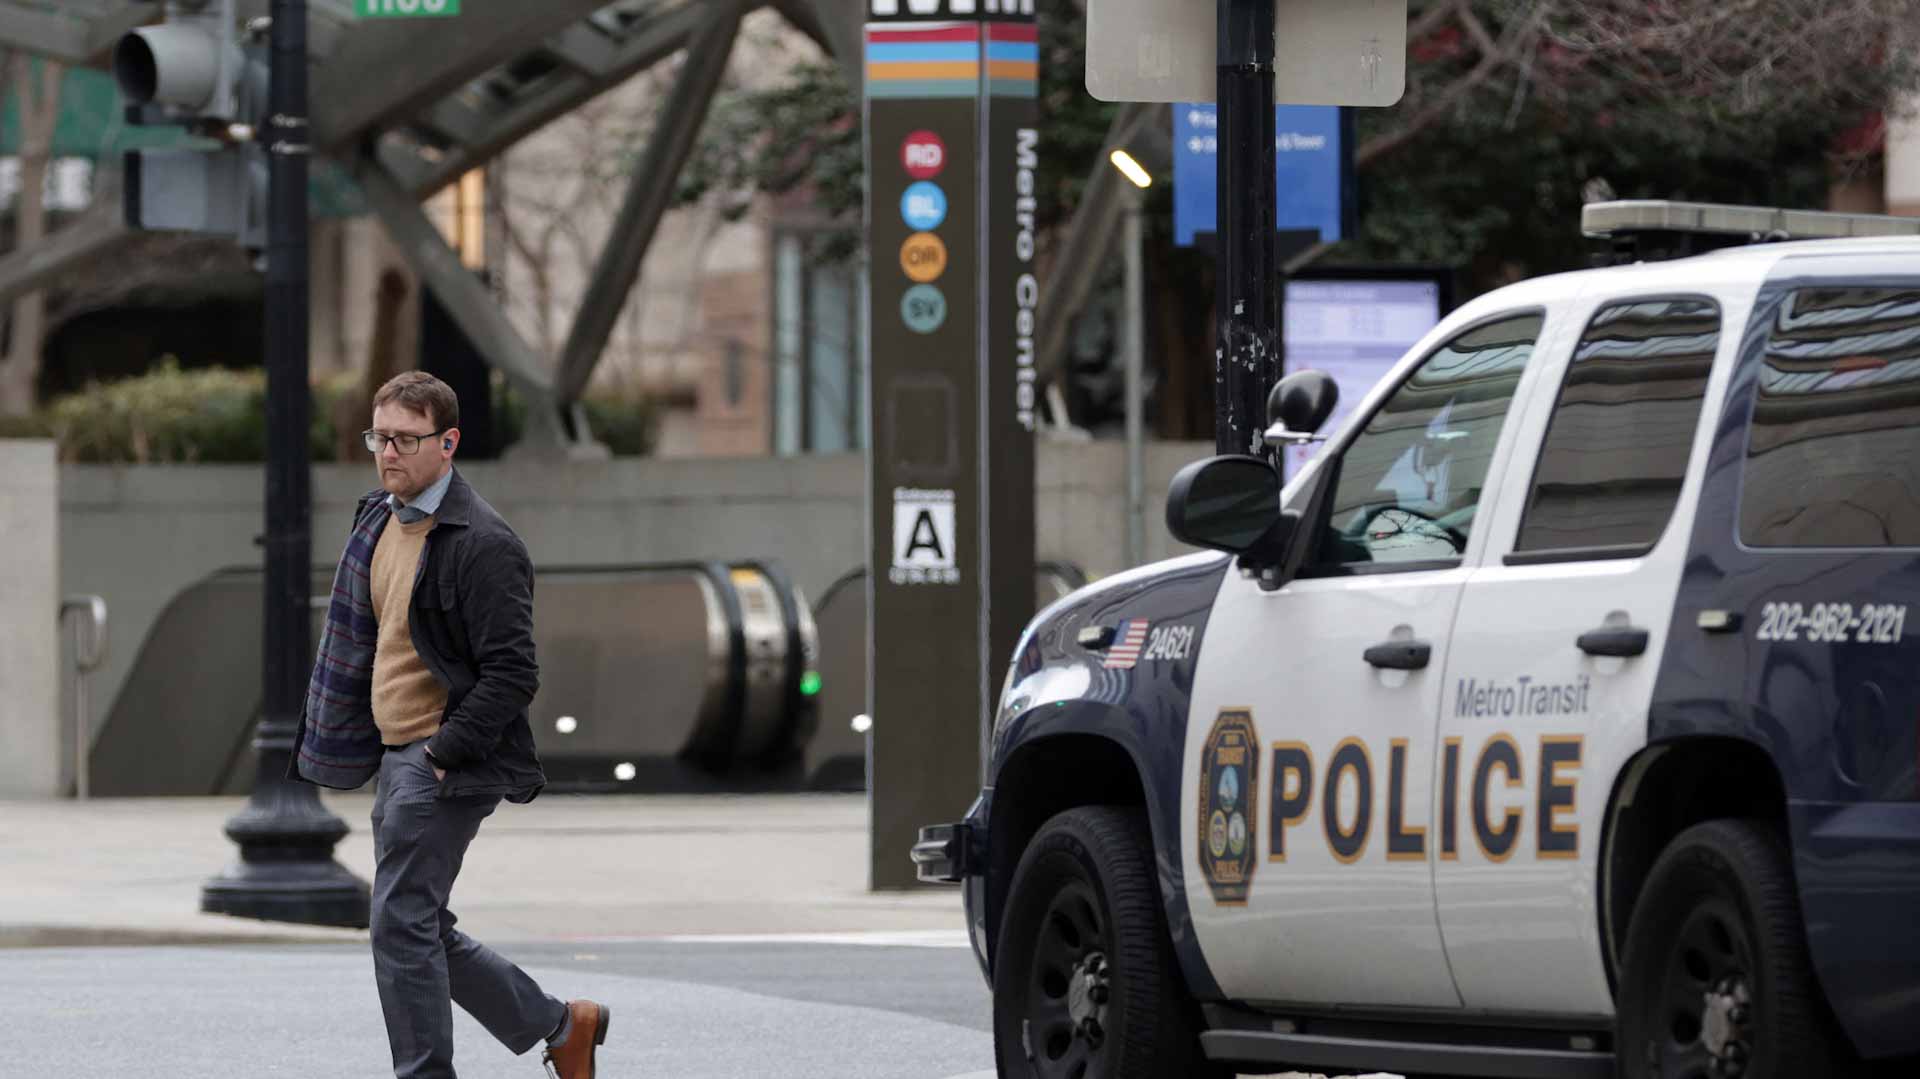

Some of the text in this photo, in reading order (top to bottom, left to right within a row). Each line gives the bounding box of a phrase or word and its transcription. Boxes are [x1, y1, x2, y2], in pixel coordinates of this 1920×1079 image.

[905, 143, 943, 168] RD
[907, 194, 942, 218] BL
[908, 246, 938, 266] OR
[1016, 128, 1039, 431] Metro Center
[908, 299, 940, 318] SV
[905, 510, 943, 559] A
[1756, 602, 1906, 643] 202-962-2121
[1144, 626, 1194, 660] 24621
[1455, 675, 1591, 717] MetroTransit
[1267, 732, 1585, 864] POLICE
